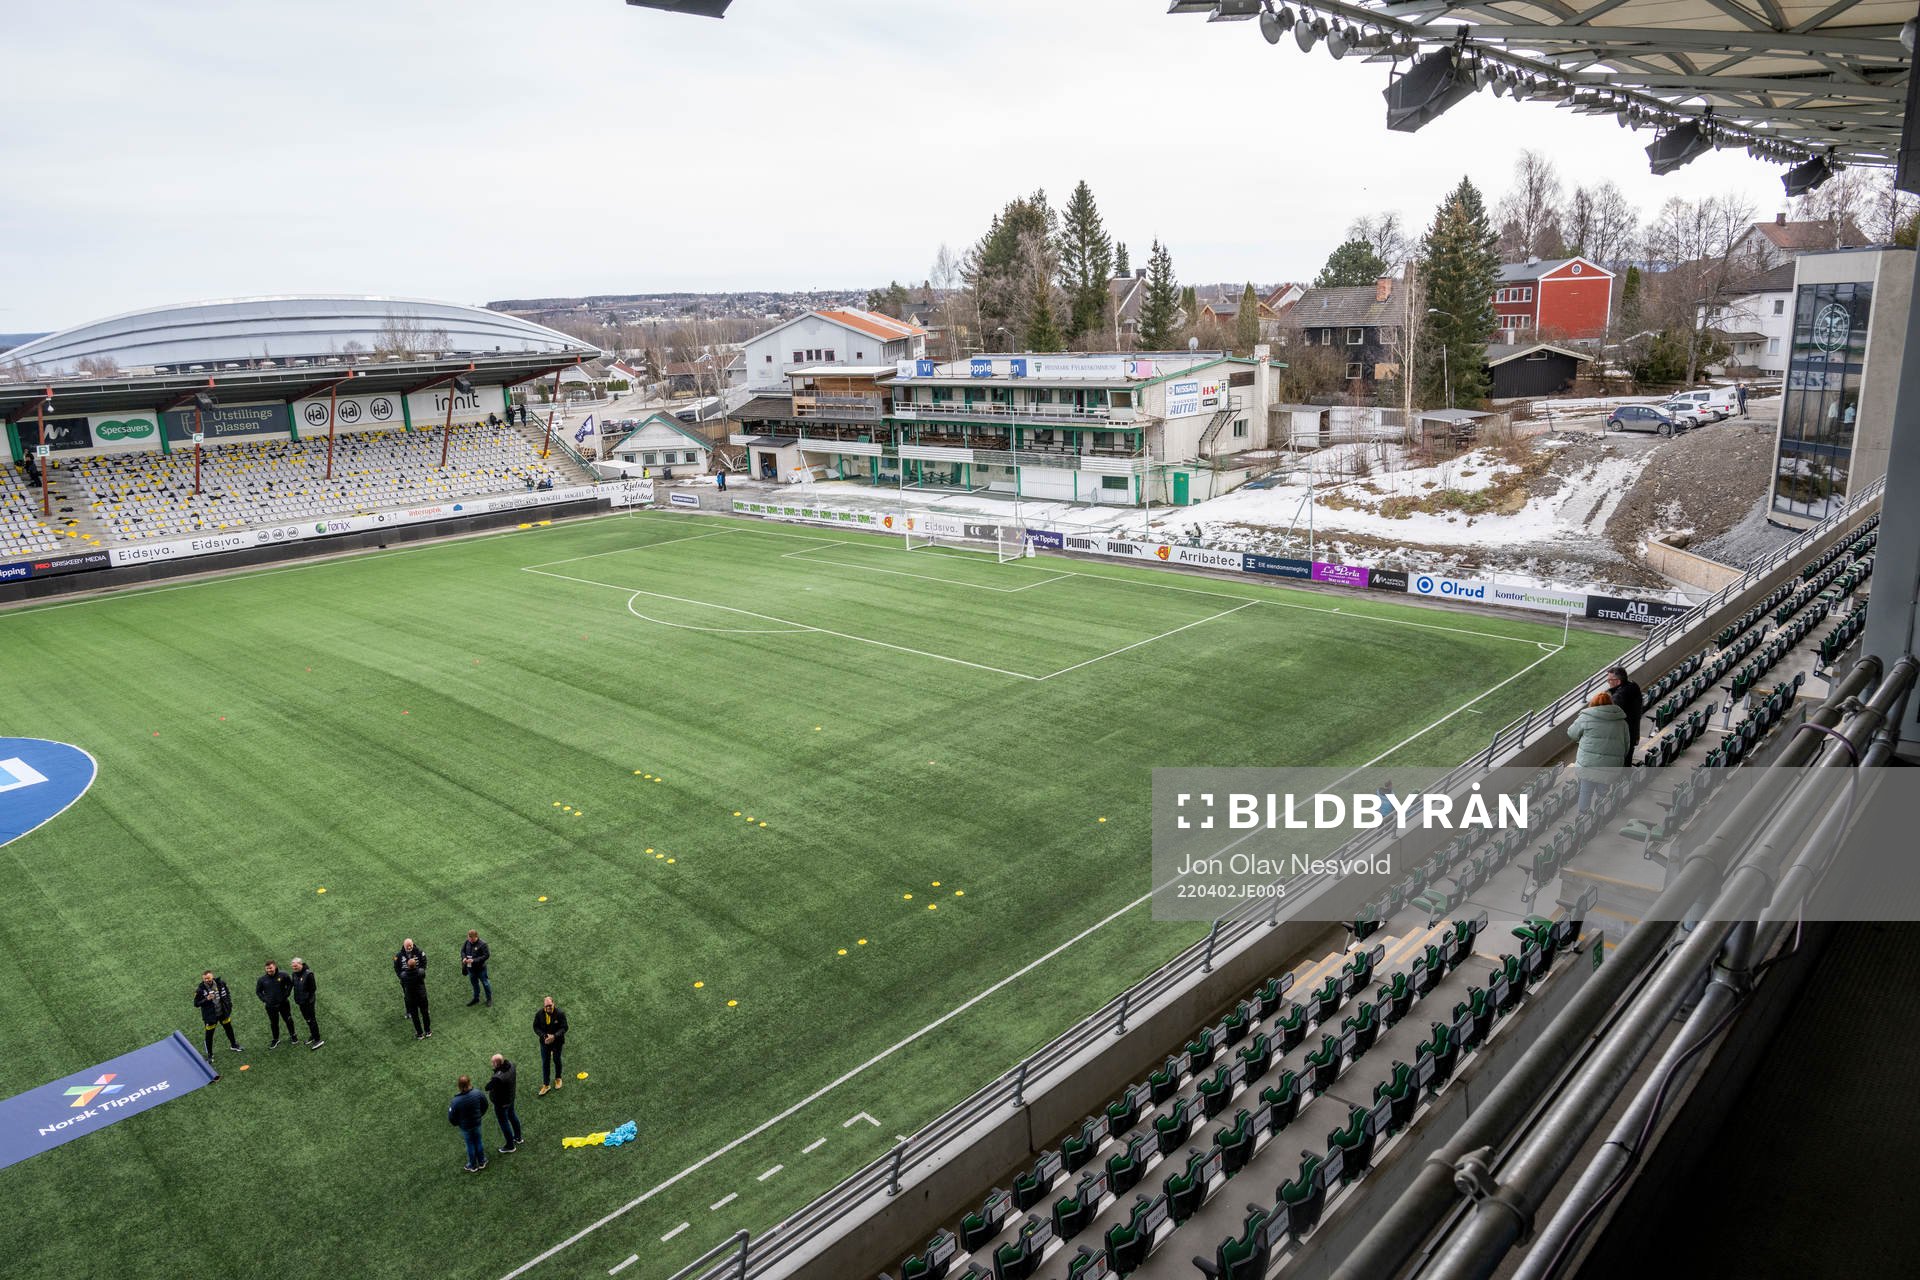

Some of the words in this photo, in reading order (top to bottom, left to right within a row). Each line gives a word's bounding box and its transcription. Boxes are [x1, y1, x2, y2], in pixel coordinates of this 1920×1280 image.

[1175, 383, 1197, 394] NISSAN
[213, 409, 273, 421] Utstillings
[101, 423, 150, 436] Specsavers
[215, 421, 260, 434] plassen
[194, 434, 202, 442] C
[39, 446, 49, 455] B
[1040, 534, 1059, 545] Tipping
[1066, 537, 1091, 549] PUMA
[1107, 541, 1133, 554] PUMA
[51, 558, 83, 568] BRISKEBY
[85, 555, 106, 563] MEDIA
[1320, 566, 1334, 574] La
[1335, 565, 1360, 577] Perla
[1441, 581, 1485, 598] Olrud
[1626, 601, 1648, 614] AO
[38, 1108, 99, 1136] Norsk
[97, 1080, 170, 1111] Tipping
